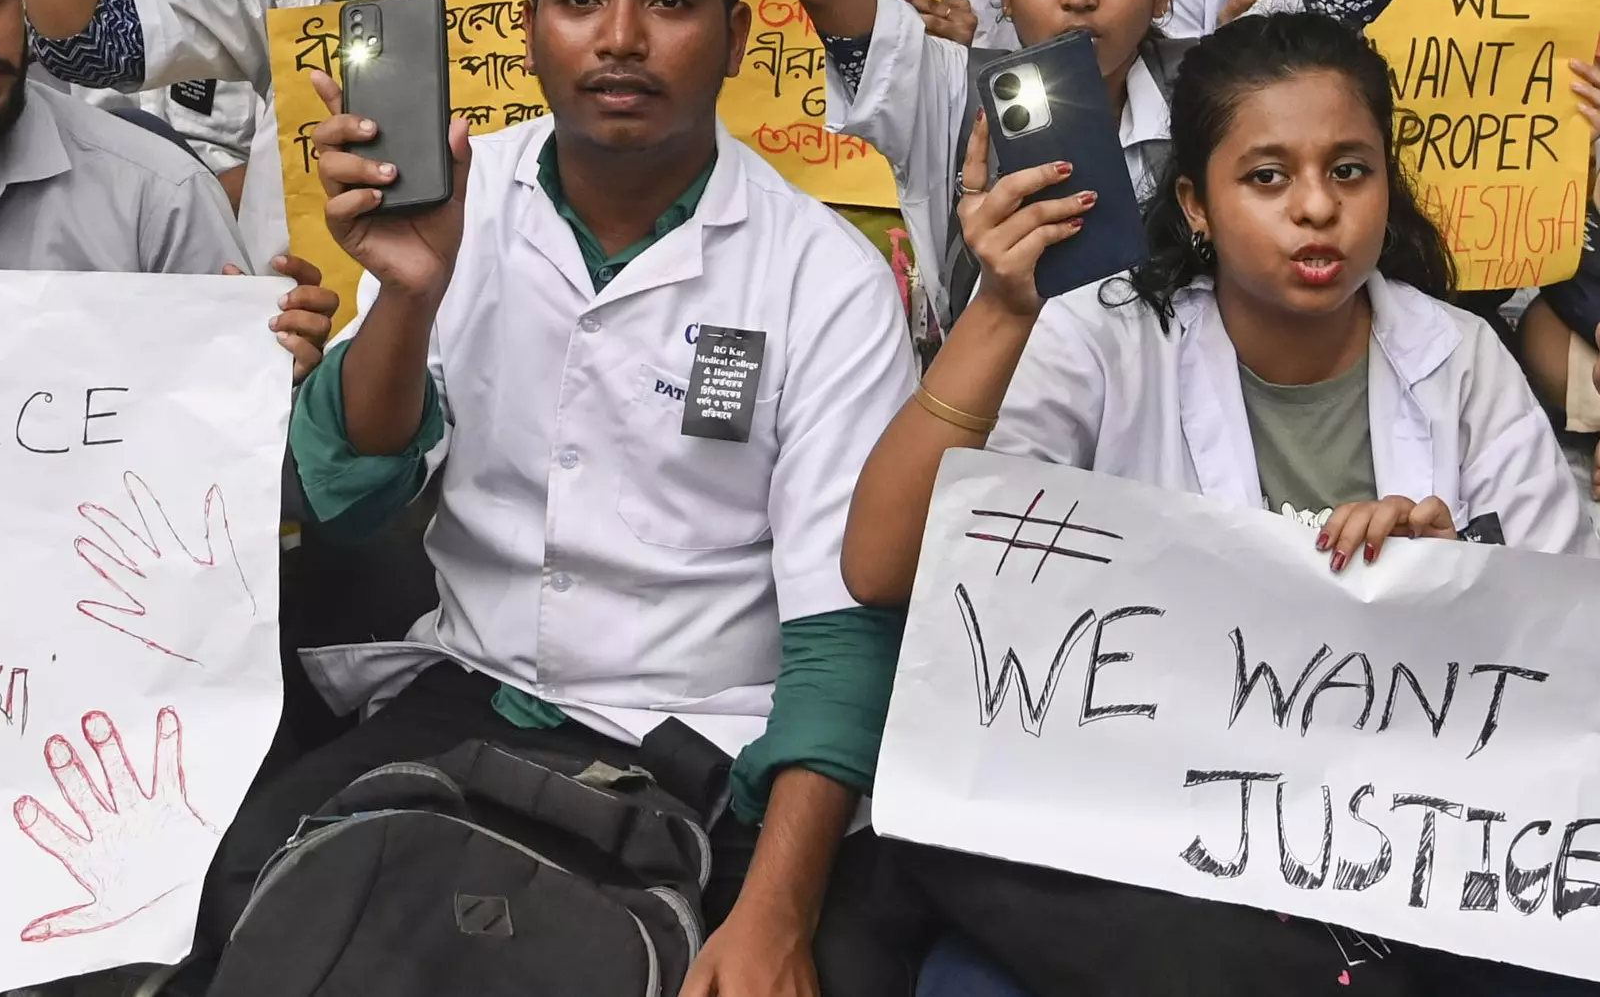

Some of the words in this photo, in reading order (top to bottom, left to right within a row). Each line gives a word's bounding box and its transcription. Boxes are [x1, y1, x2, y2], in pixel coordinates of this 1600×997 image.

[1521, 40, 1555, 105] A
[1398, 112, 1560, 173] PROPER
[696, 354, 728, 366] Medical
[729, 359, 759, 370] College
[713, 345, 727, 355] RG
[729, 347, 746, 357] Kar
[703, 367, 711, 375] &
[713, 367, 748, 379] Hospital
[954, 582, 1166, 738] WE
[1228, 626, 1550, 761] WANT
